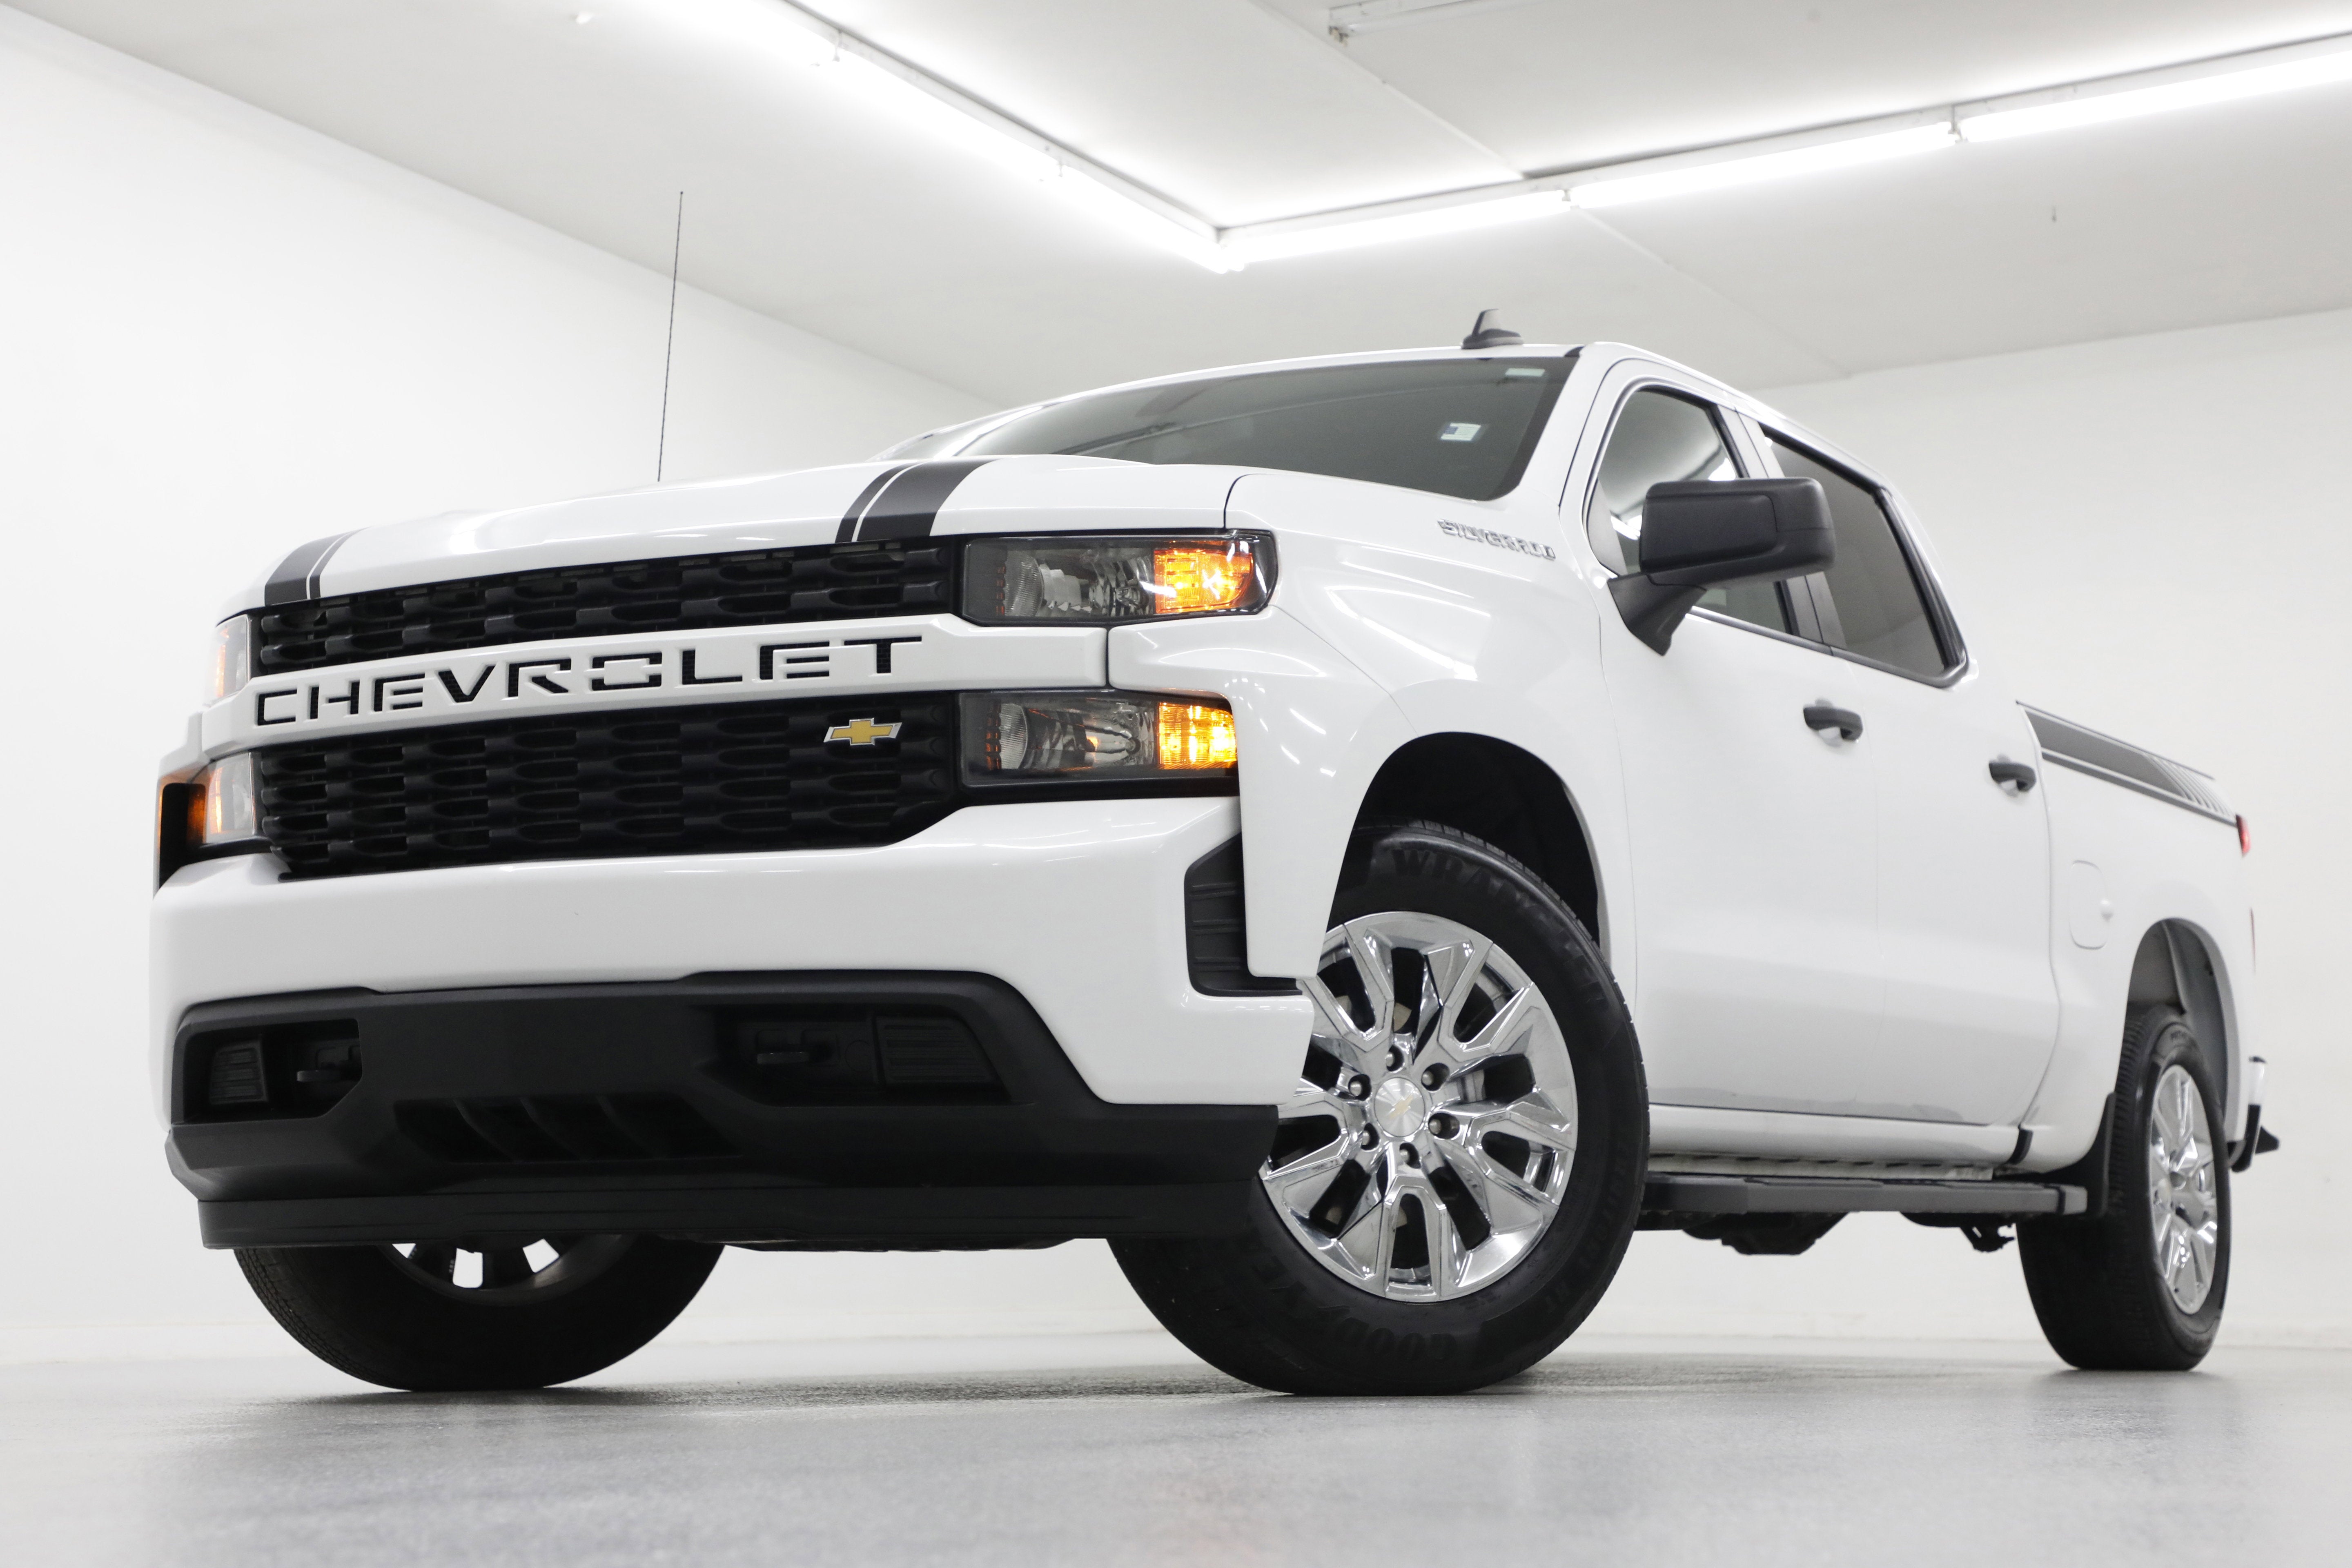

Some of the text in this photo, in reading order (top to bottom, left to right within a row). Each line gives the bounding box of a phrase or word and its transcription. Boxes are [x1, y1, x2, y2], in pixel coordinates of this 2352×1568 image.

[1437, 518, 1556, 561] SILVERADO
[256, 636, 922, 726] CHEVROLET
[1391, 847, 1610, 1015] WRANGLER
[1227, 1219, 1459, 1361] GOODYEA
